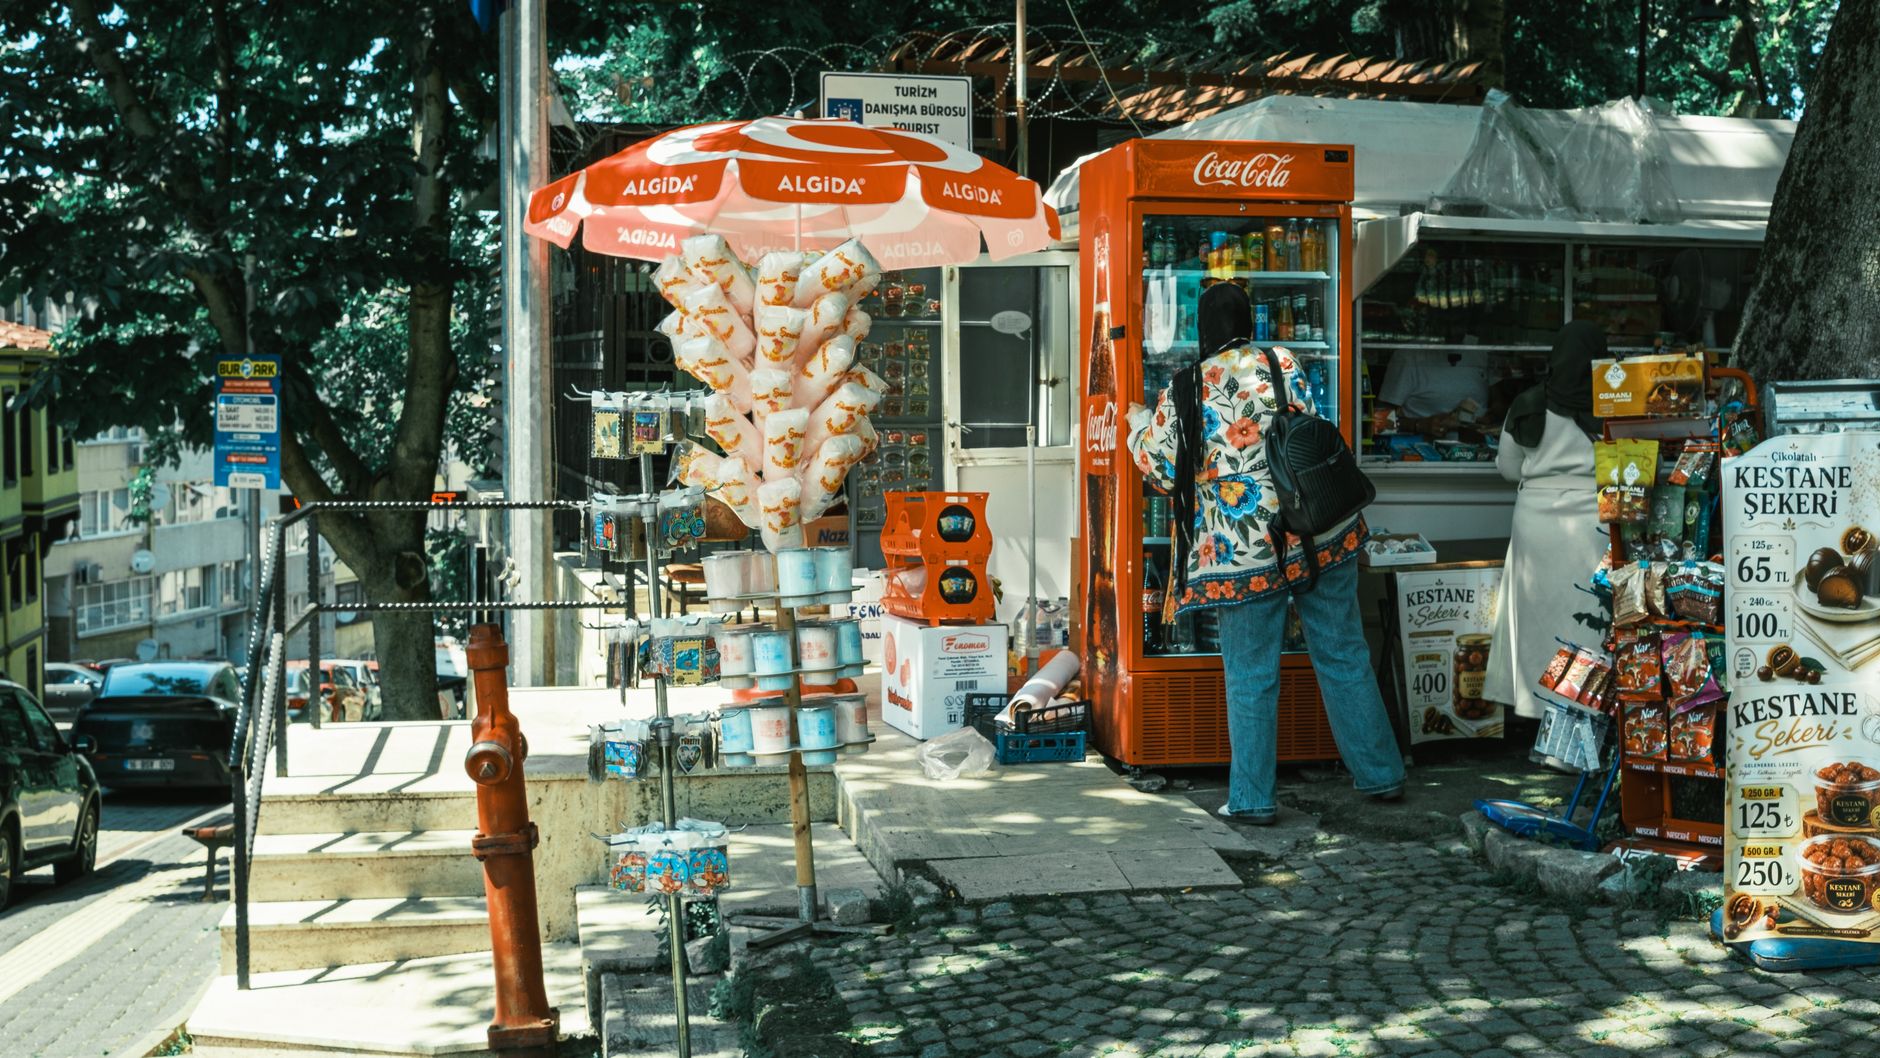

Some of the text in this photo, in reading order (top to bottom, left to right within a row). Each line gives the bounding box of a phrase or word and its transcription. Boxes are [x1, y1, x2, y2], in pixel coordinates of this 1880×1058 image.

[895, 85, 938, 98] TURİZM
[865, 103, 966, 117] DANIŞMA BÜROSU
[1598, 391, 1632, 400] OSMANLI
[1771, 451, 1817, 463] Çikolatalı
[1734, 465, 1852, 489] KESTANE
[1751, 540, 1766, 550] 125
[1737, 556, 1790, 583] 65 TL
[1406, 589, 1475, 608] KESTANE
[1749, 597, 1765, 607] 240
[1414, 605, 1461, 628] Şekeri
[1735, 612, 1790, 639] 100 TL
[945, 637, 987, 651] Fenomen
[1633, 643, 1651, 656] Nar
[1412, 672, 1447, 696] 400
[1641, 707, 1658, 720] Nar
[1687, 711, 1704, 723] Nar
[1734, 692, 1858, 729] KESTANE
[1750, 720, 1838, 760] Şekeri
[1748, 786, 1777, 797] 250 GR.
[1739, 802, 1781, 828] 125
[1747, 845, 1776, 856] 500 GR.
[1738, 861, 1783, 886] 250
